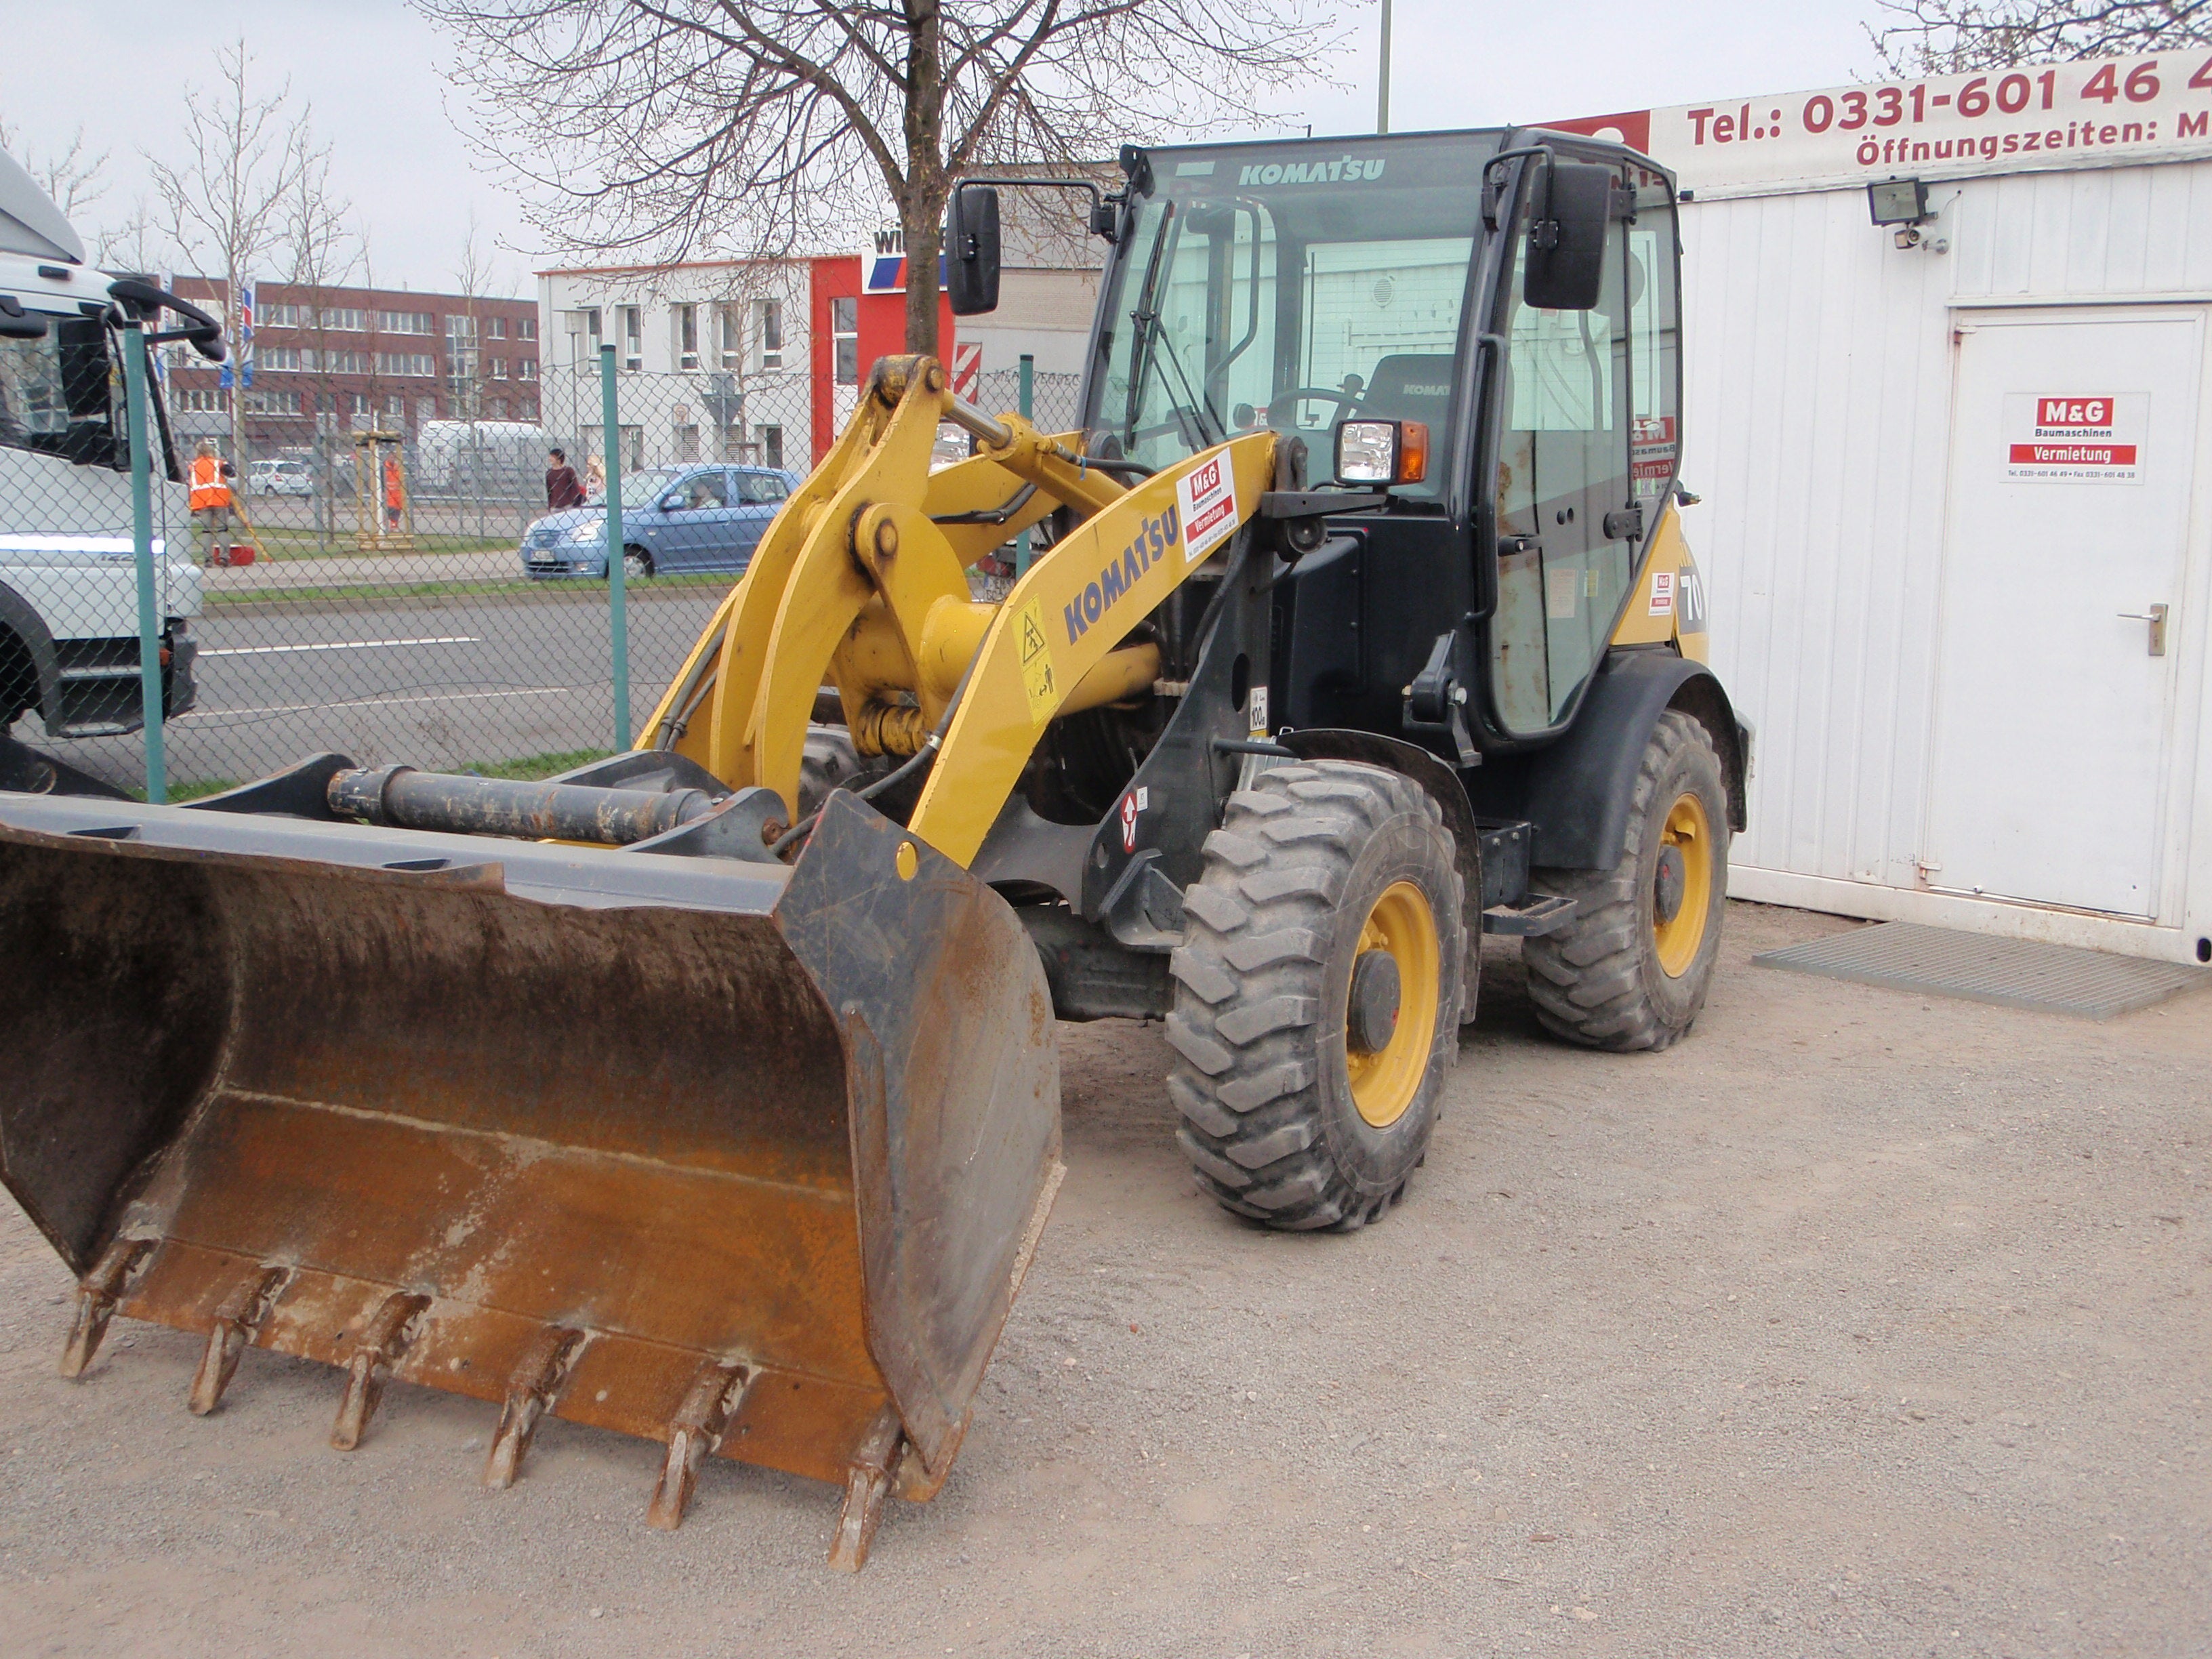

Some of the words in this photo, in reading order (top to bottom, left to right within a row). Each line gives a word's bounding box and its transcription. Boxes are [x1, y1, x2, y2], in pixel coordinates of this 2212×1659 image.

[1687, 102, 1782, 146] Tel.:
[1803, 70, 2055, 134] 0331-601
[2081, 60, 2160, 104] 46
[1856, 120, 2157, 166] Öffnungszeiten:
[1238, 155, 1386, 186] KOMATSU
[2045, 401, 2104, 422] M&G
[2035, 428, 2112, 437] Baumaschinen
[2034, 446, 2112, 464] Vermietung
[1193, 464, 1218, 496] M&G
[1063, 504, 1179, 646] KOMATSU
